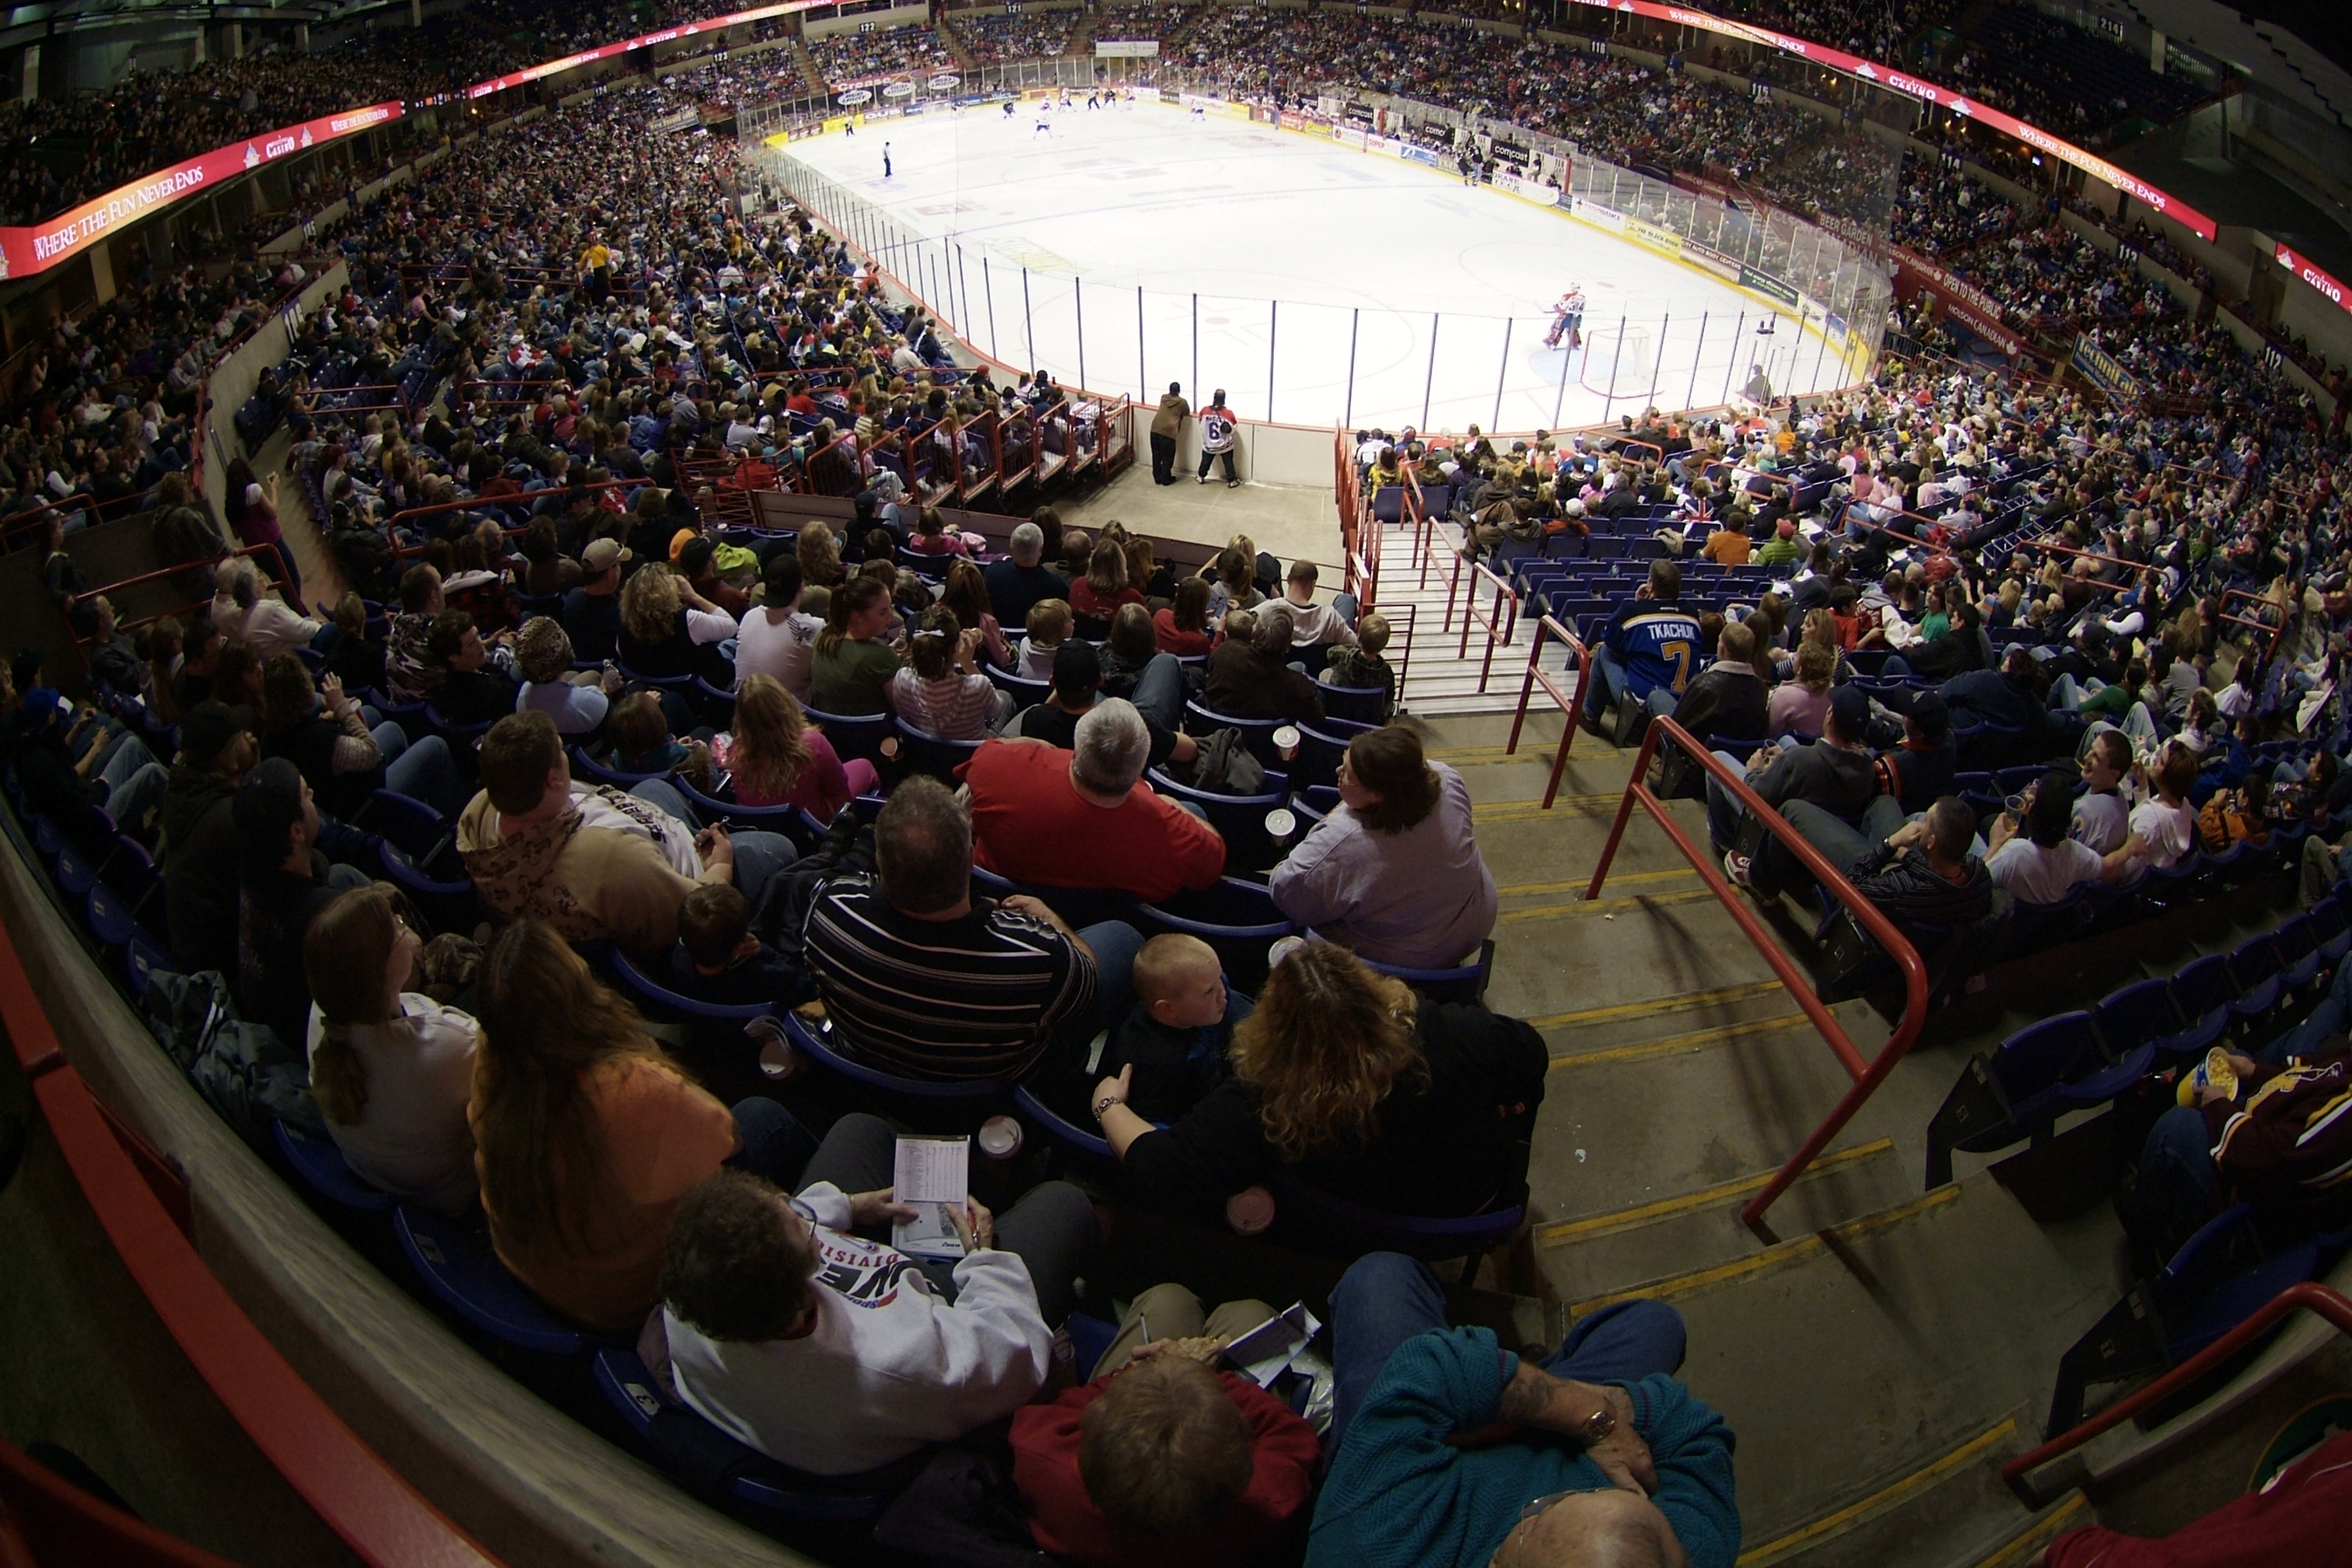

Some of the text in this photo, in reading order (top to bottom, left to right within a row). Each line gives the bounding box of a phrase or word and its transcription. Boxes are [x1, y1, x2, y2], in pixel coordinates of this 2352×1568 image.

[1008, 5, 1020, 13] 121
[859, 23, 875, 33] 122
[1669, 10, 1701, 25] WHERE
[1703, 18, 1722, 30] THE
[1724, 23, 1743, 35] FUN
[1778, 37, 1805, 53] ENDS
[2101, 17, 2119, 34] 214
[714, 51, 728, 61] 123
[1591, 41, 1605, 54] 116
[837, 77, 892, 92] Crease
[1752, 83, 1768, 96] 115
[1889, 75, 1936, 100] CASINO
[842, 95, 866, 103] LIGHT
[1348, 107, 1373, 120] comcast
[266, 136, 295, 158] CASINO
[1494, 144, 1528, 162] comcast
[1941, 152, 1962, 169] 114
[2018, 126, 2165, 208] WHERE THE FUN NEVER ENDS
[33, 166, 203, 261] WHERE THE FUN NEVER ENDS
[1819, 214, 1873, 247] BEER GARDEN
[1692, 244, 1705, 254] AUTO
[1705, 249, 1719, 260] BODY
[1719, 257, 1741, 270] CENTERS
[1906, 255, 1934, 277] CANADIAN
[2303, 268, 2341, 303] CASINO
[1944, 273, 2001, 320] OPEN TO THE PUBLIC
[1948, 303, 2007, 349] MOLSON CANADIAN
[2265, 347, 2280, 369] 112
[1209, 422, 1220, 440] 6
[1647, 624, 1695, 640] TKACHUK
[1661, 640, 1691, 692] 7
[817, 1240, 900, 1268] DIVISI
[636, 1395, 654, 1405] 3
